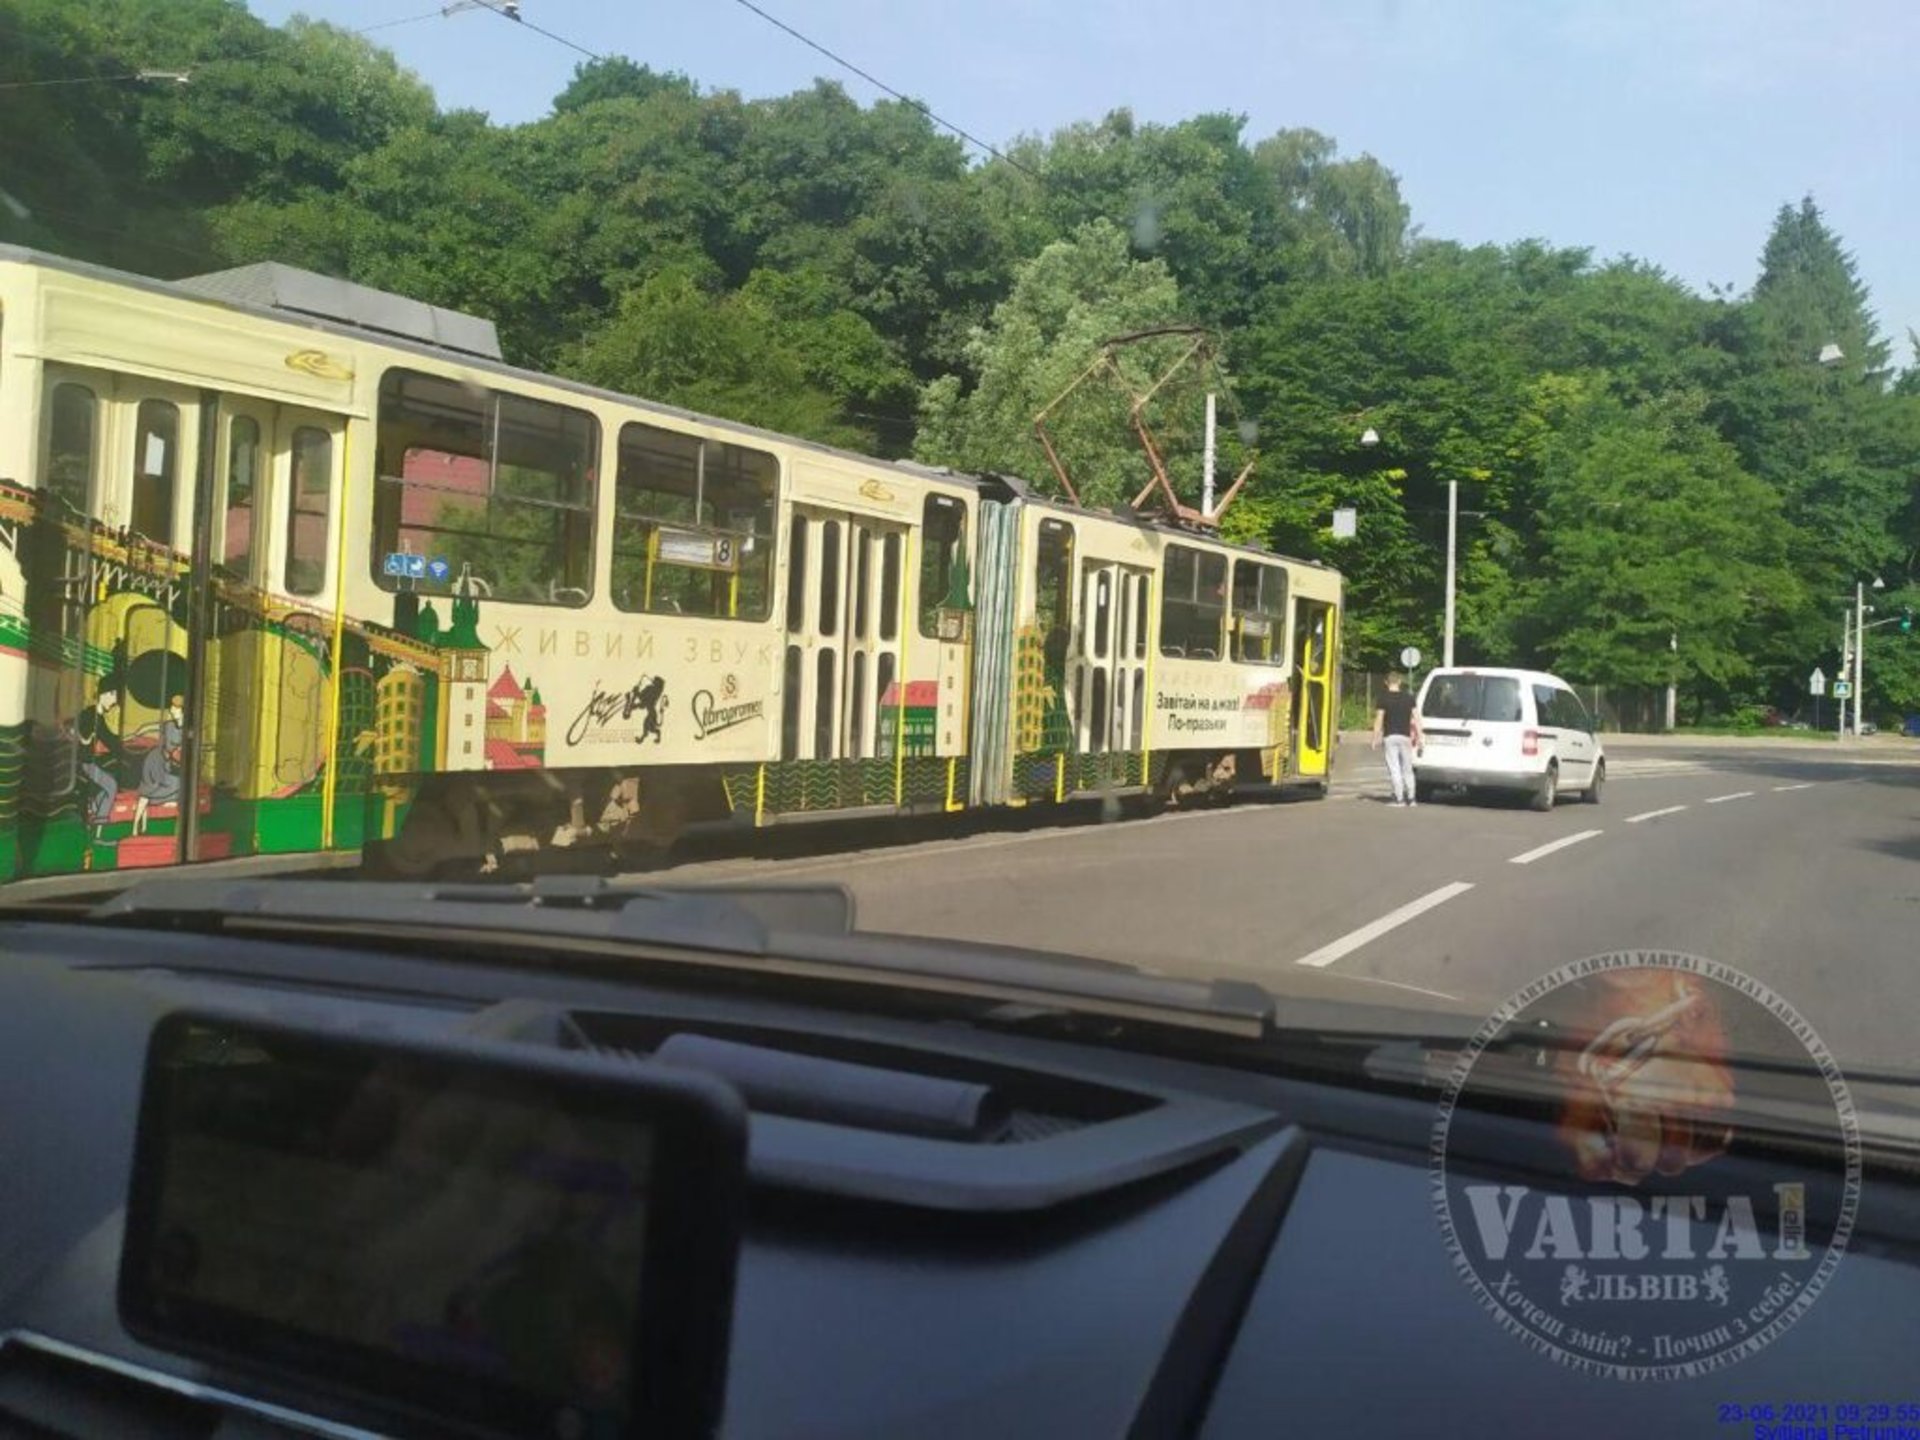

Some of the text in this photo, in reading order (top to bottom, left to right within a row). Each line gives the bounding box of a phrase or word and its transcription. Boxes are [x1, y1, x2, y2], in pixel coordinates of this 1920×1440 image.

[719, 540, 730, 562] 8
[495, 624, 771, 664] ЖИВИЙ ЗВУК
[1157, 691, 1196, 710] Завітай
[1198, 698, 1210, 711] на
[1168, 713, 1227, 736] По-празьки
